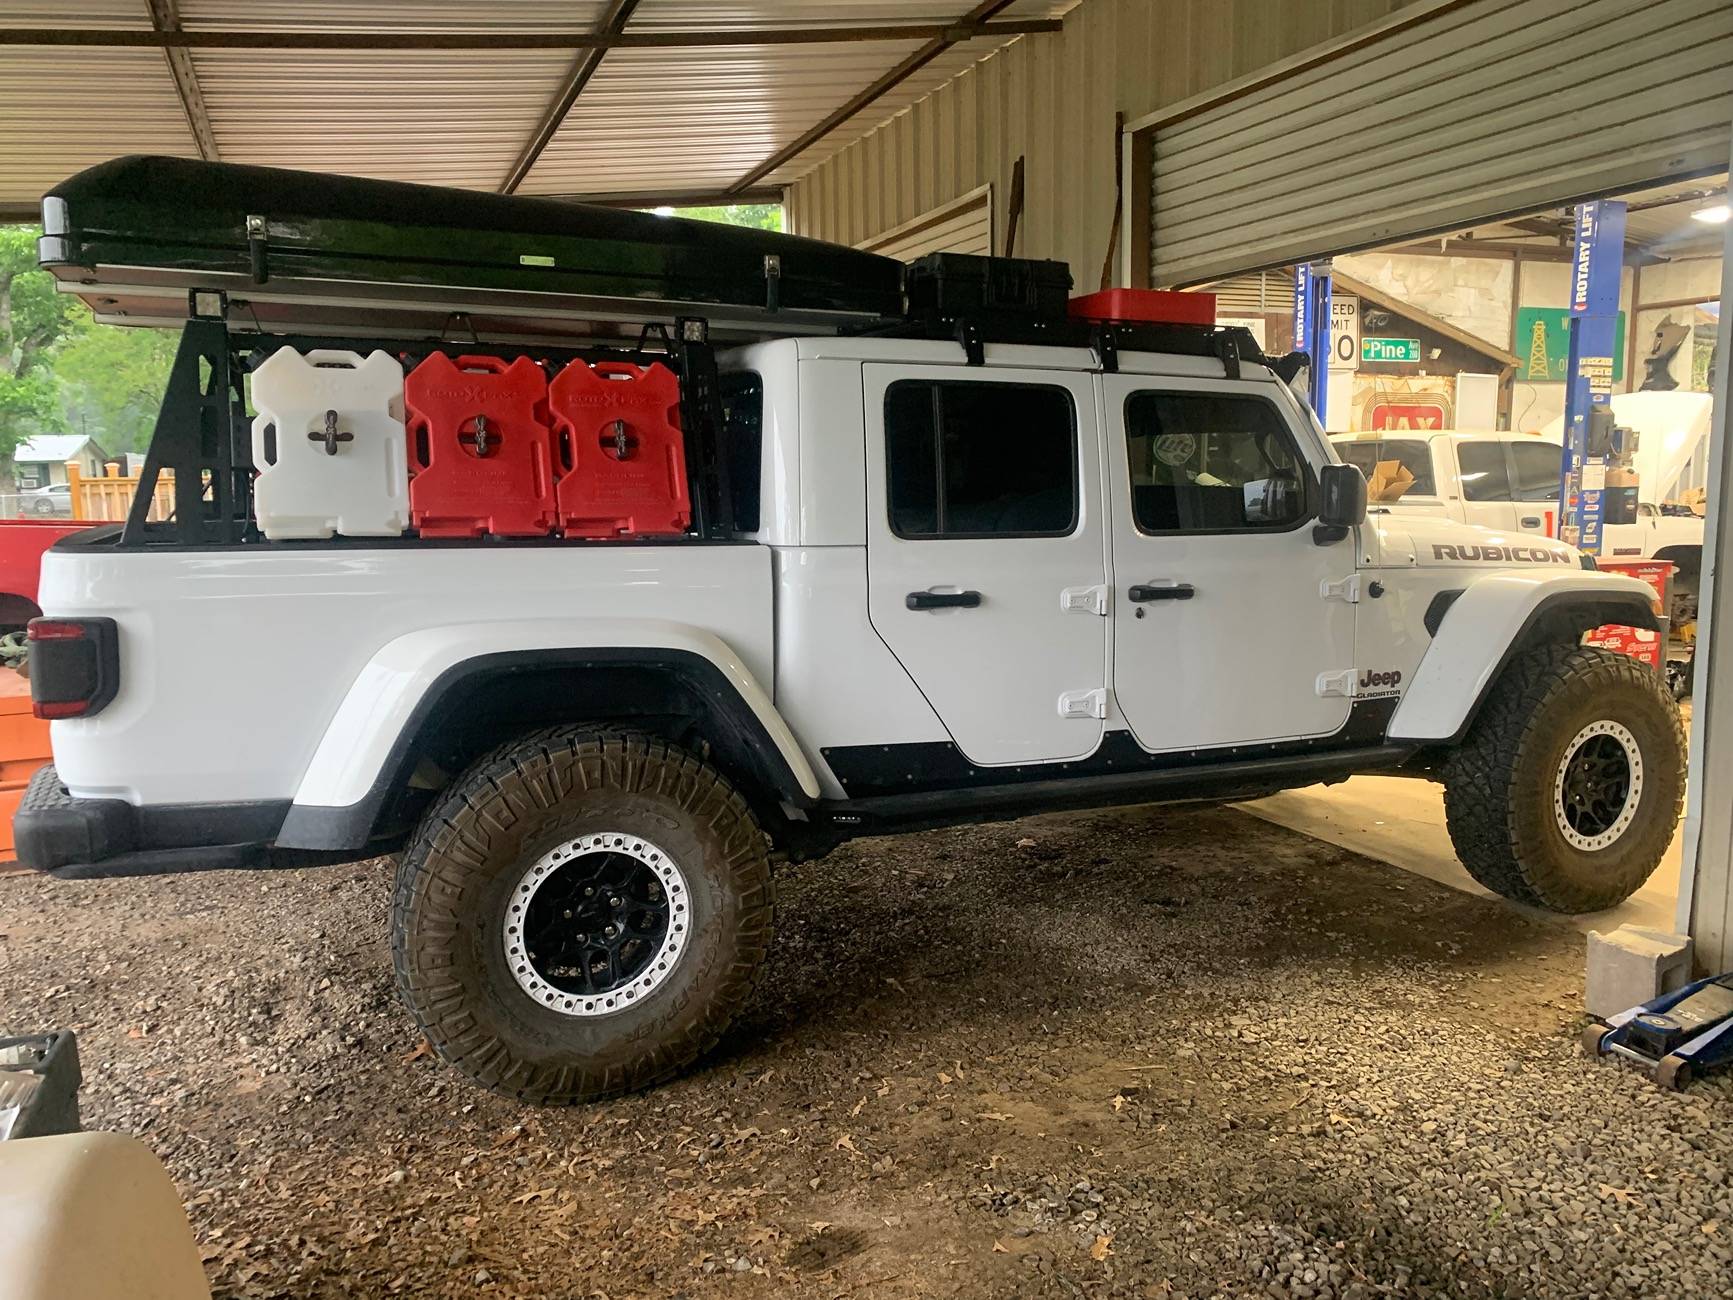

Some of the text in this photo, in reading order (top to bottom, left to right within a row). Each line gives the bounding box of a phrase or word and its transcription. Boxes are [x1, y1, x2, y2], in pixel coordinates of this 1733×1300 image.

[1576, 204, 1594, 303] ROTARY LIFT
[1296, 266, 1306, 340] ROTARY LIFT
[1332, 303, 1355, 315] EED
[1331, 319, 1350, 331] MIT
[1370, 341, 1406, 358] Pine
[1431, 544, 1571, 564] RUBICON
[1360, 669, 1401, 688] Jeep
[1356, 689, 1401, 699] GLADIATOR
